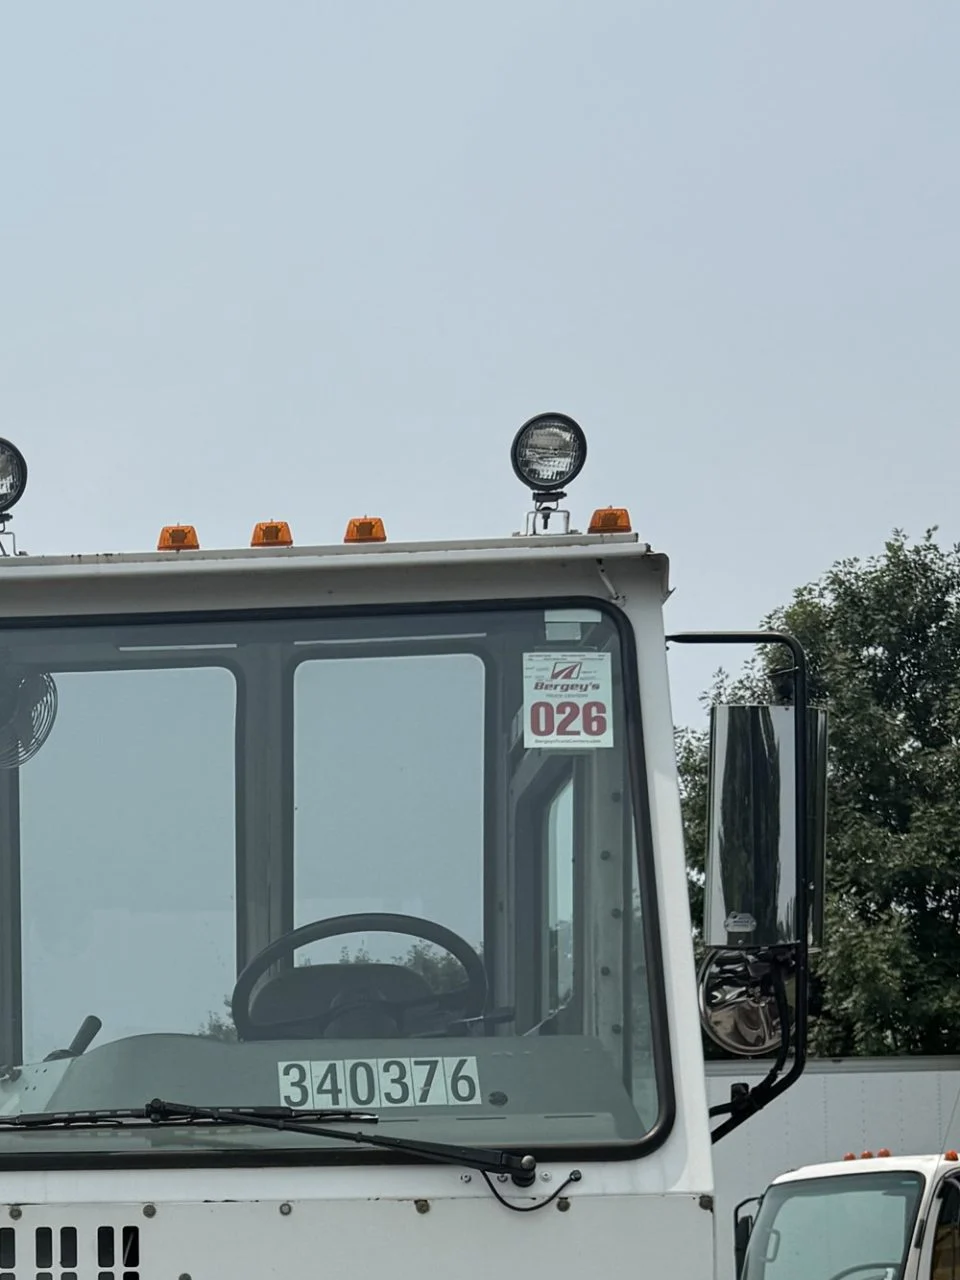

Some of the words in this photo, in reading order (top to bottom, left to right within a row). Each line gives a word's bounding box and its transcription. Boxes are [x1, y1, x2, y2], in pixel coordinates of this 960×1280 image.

[533, 681, 601, 693] Bergey's
[530, 701, 607, 737] 026
[282, 1058, 477, 1108] 340376
